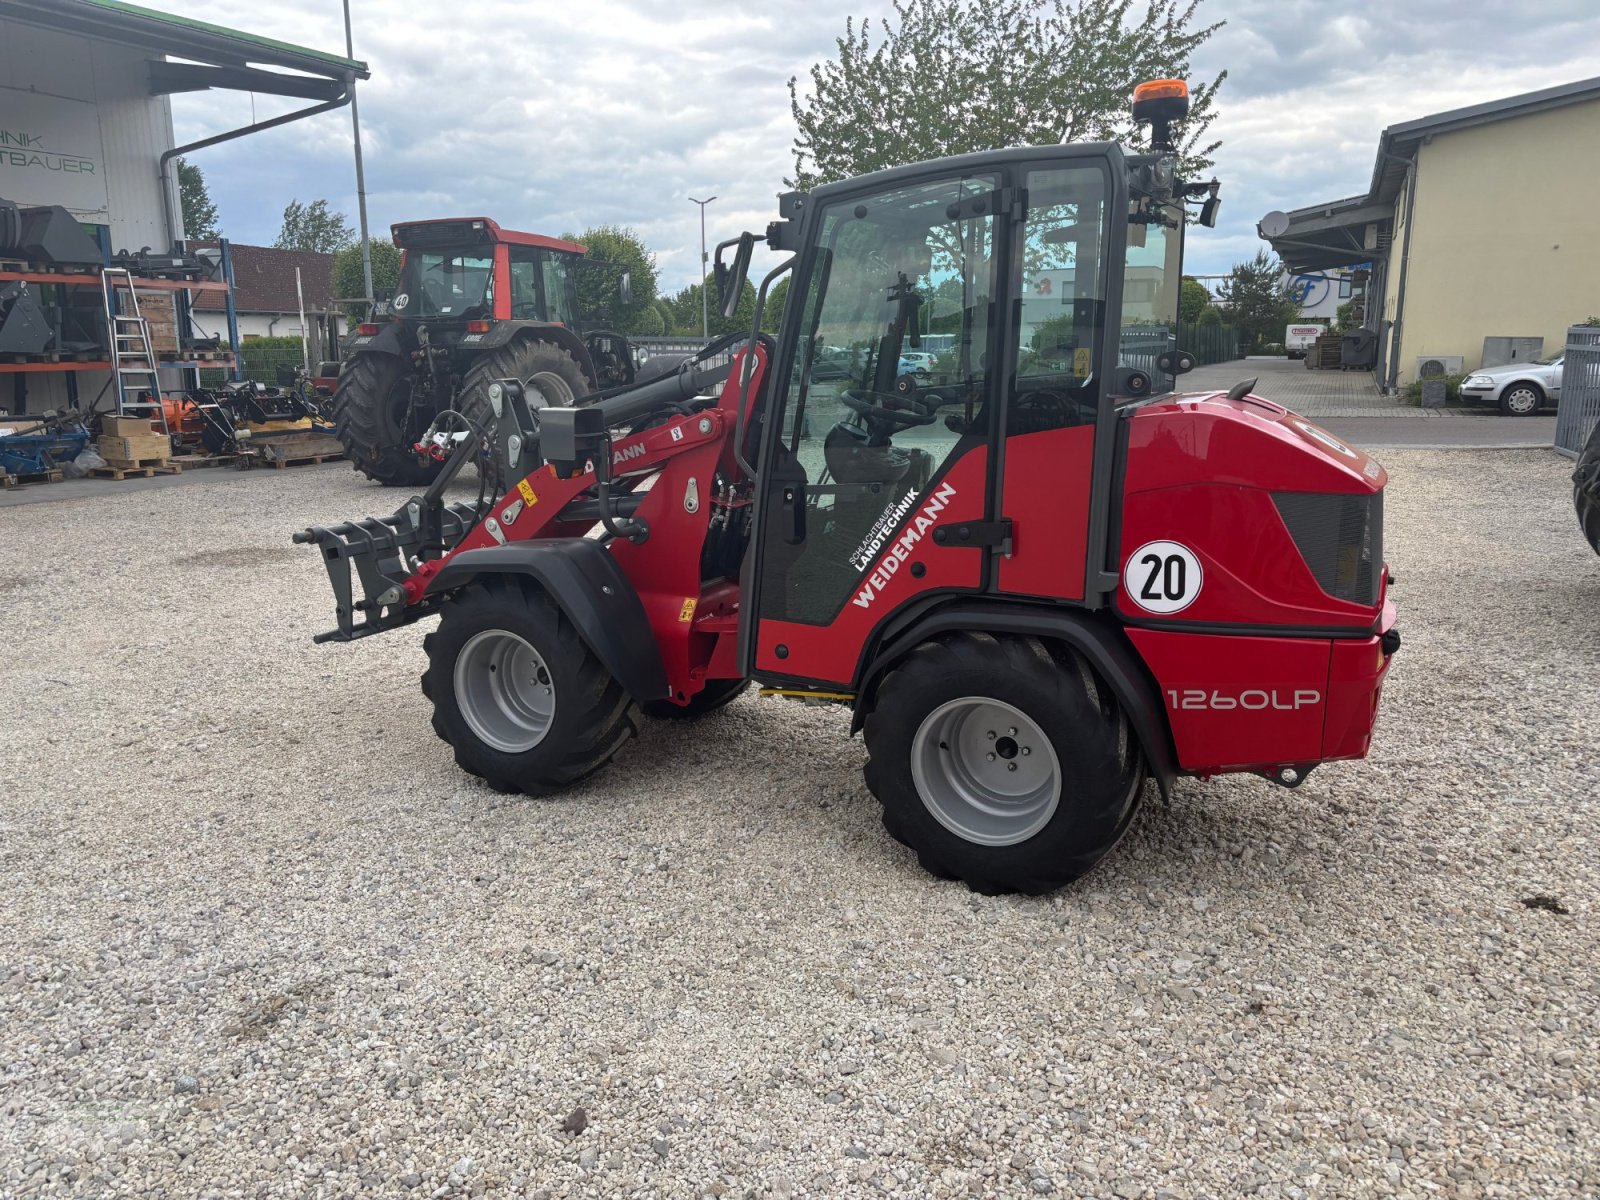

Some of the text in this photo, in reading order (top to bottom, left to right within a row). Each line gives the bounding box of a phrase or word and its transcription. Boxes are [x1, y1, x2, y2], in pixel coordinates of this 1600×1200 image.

[848, 501, 897, 565] SCHLACHTBAUER
[852, 481, 957, 609] WEIDEMANN
[854, 486, 920, 573] LANDTECHNIK
[1140, 553, 1187, 601] 20
[1167, 689, 1322, 711] 1260LP
